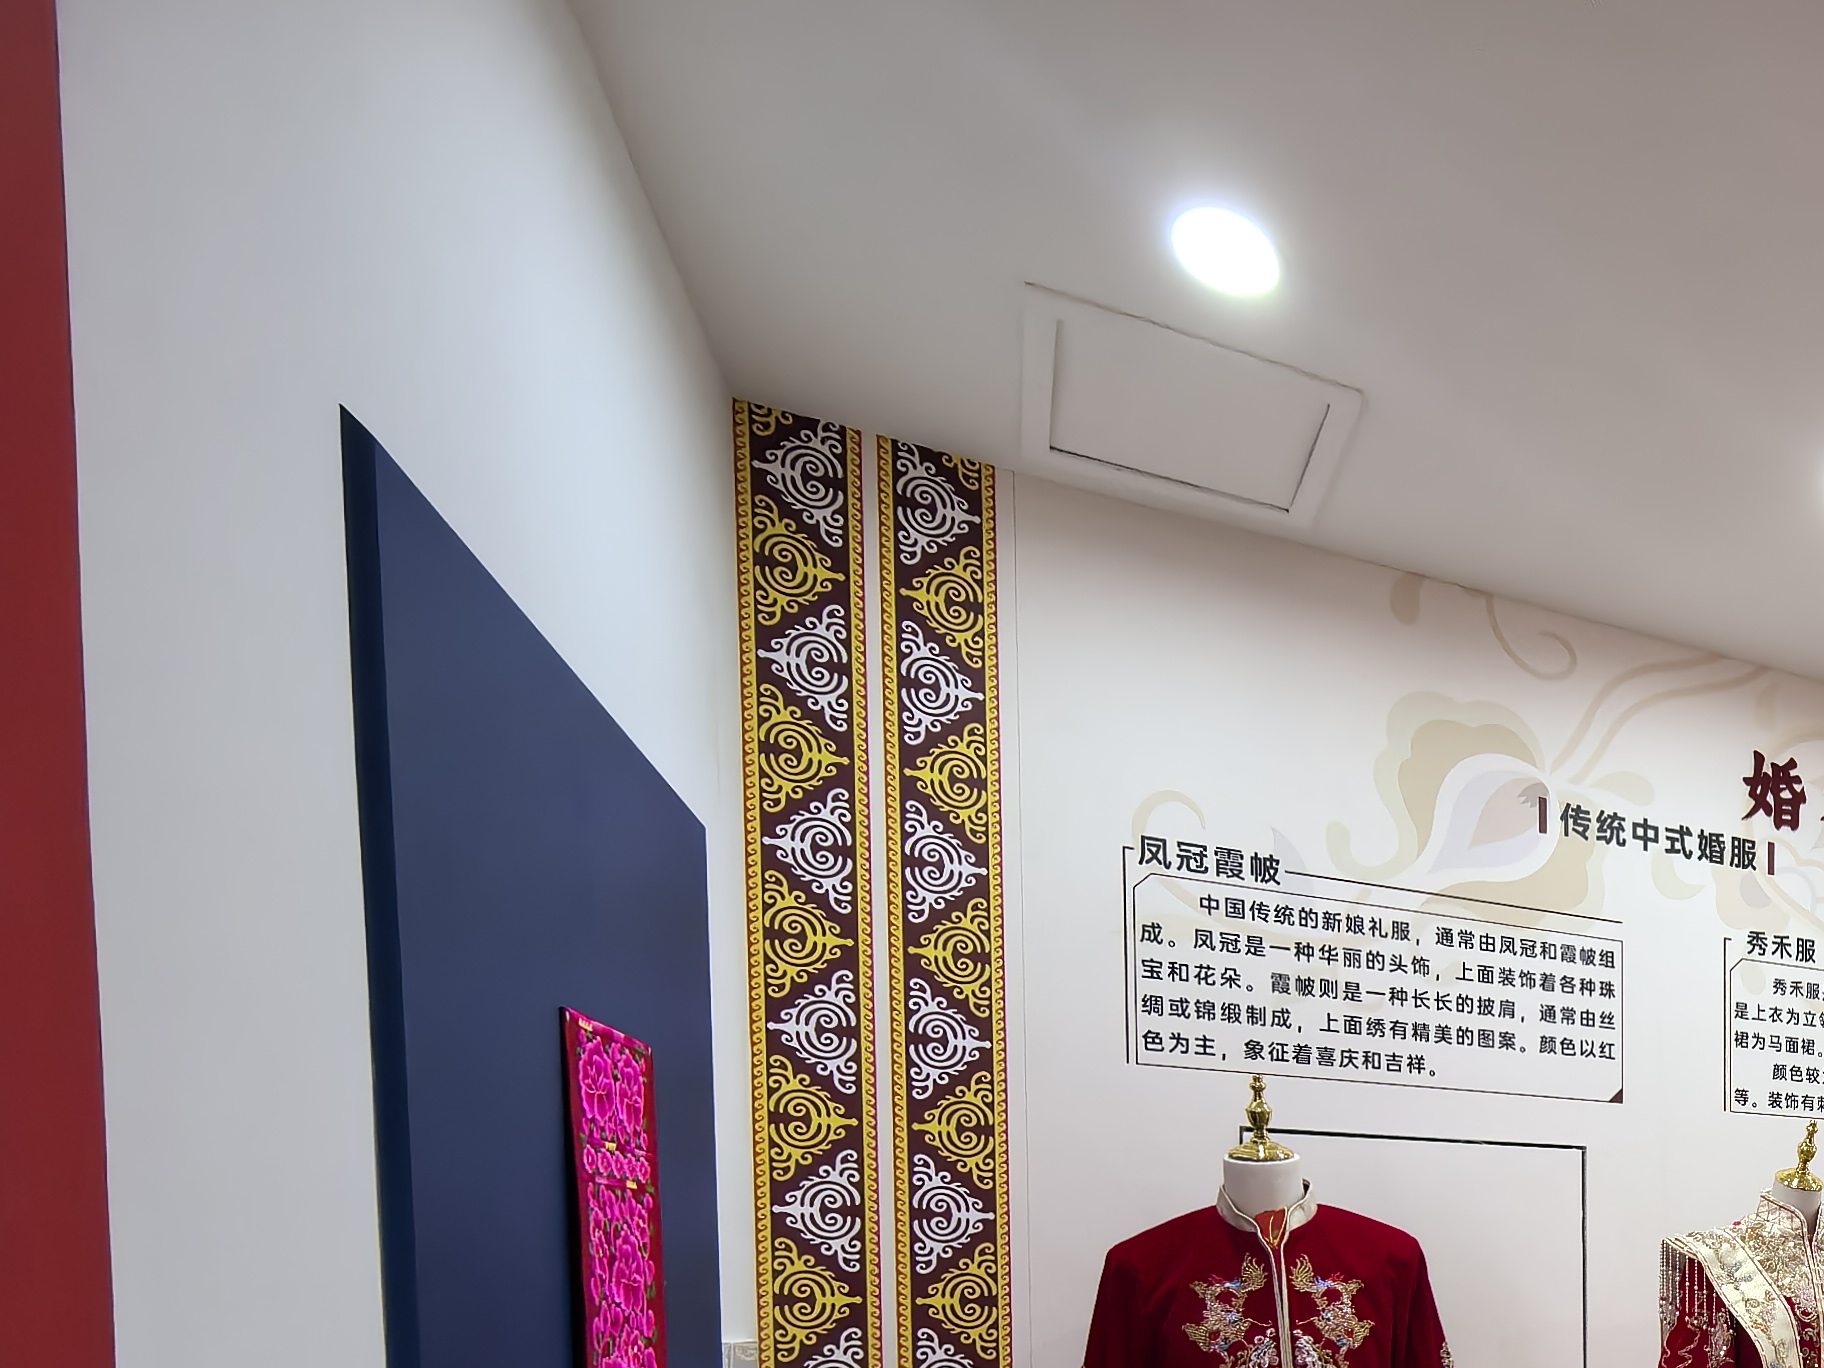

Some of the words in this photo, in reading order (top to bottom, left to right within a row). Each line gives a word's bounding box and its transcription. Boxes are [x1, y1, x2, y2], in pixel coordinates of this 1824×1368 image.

[1137, 836, 1282, 886] 凤冠霞帔
[1560, 802, 1758, 872] 传统中式婚服
[1140, 922, 1616, 1000] 成。凤冠是一种华丽的头饰，上面装饰着各种珠
[1199, 894, 1616, 970] 中国传统的新娘礼服，通常由凤冠和霞帔组
[1746, 930, 1816, 963] 秀禾服
[1140, 958, 1616, 1030] 宝和花朵。霞帔则是一种长长的披肩，通常由丝
[1142, 1030, 1438, 1078] 色为主，象征着喜庆和吉祥。
[1734, 1031, 1824, 1058] 裙为马面裙。
